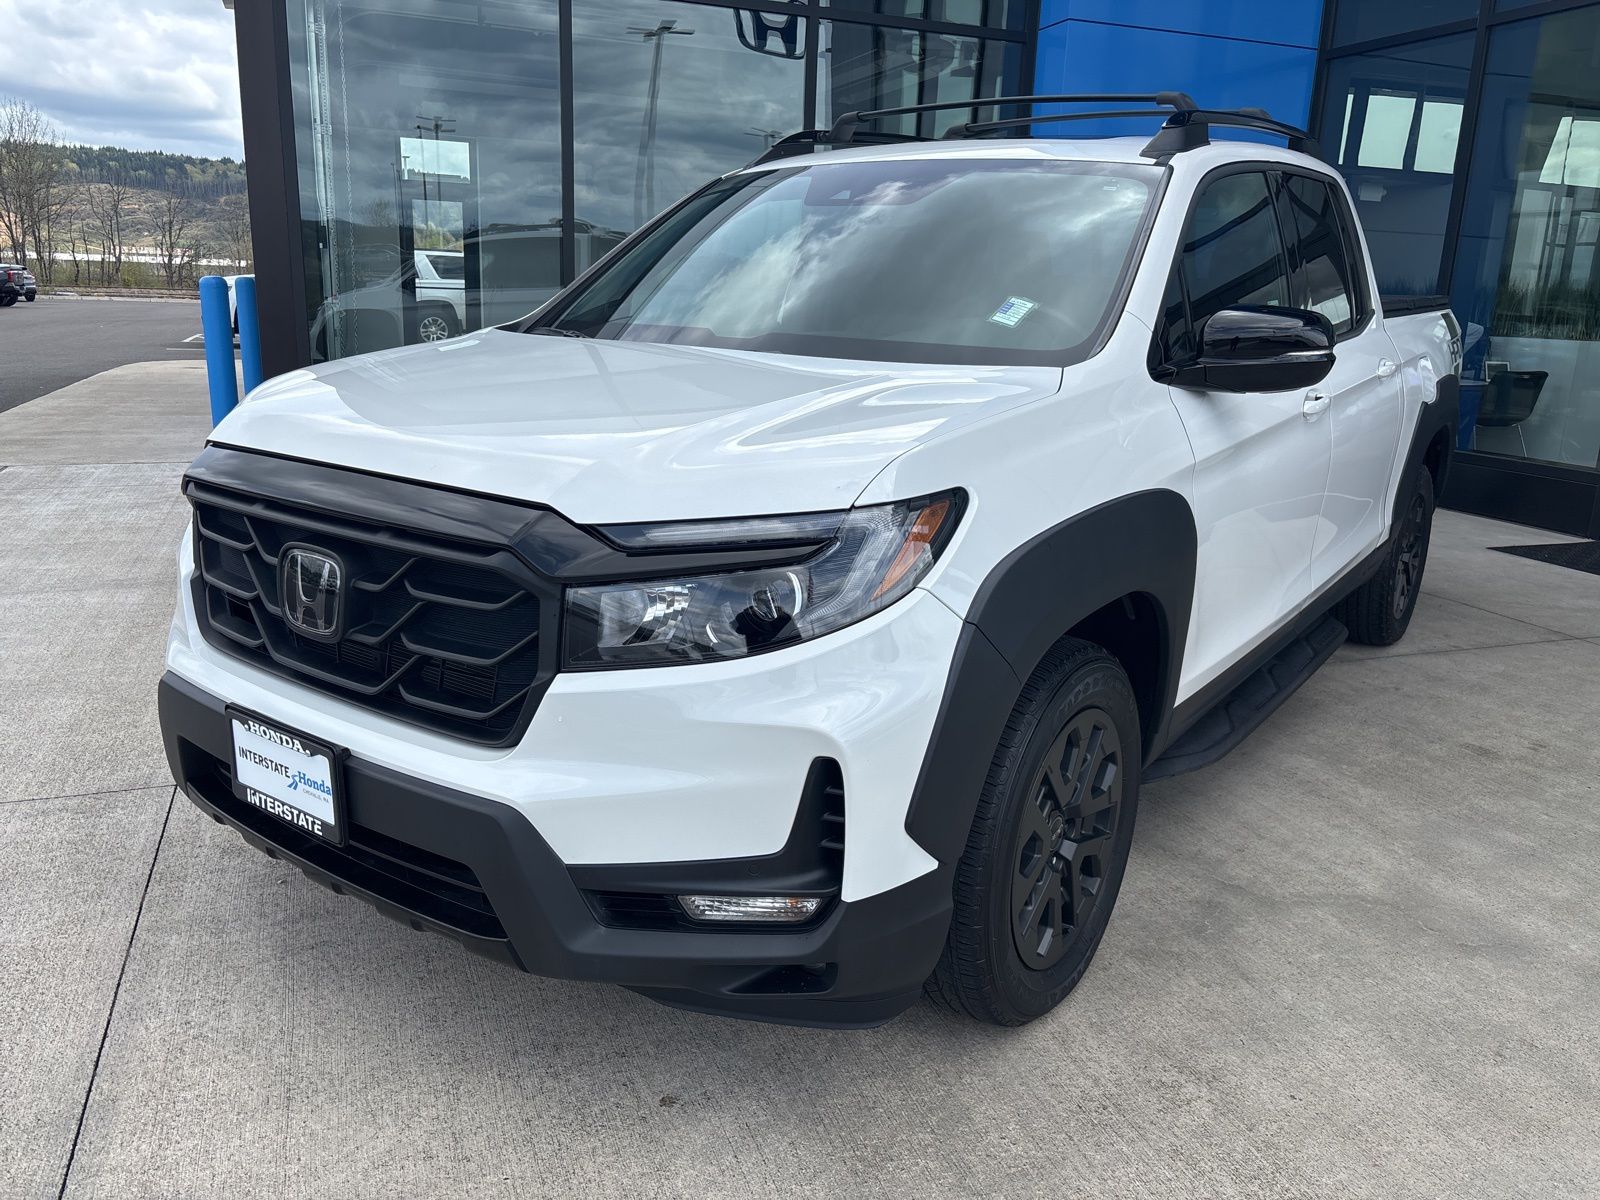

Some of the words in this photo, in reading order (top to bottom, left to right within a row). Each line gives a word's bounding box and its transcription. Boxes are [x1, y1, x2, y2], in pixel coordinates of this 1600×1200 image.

[248, 720, 307, 756] HONDA
[238, 746, 291, 779] INTERSTATE
[297, 771, 332, 796] Honda
[246, 787, 323, 836] INTERSTATE
